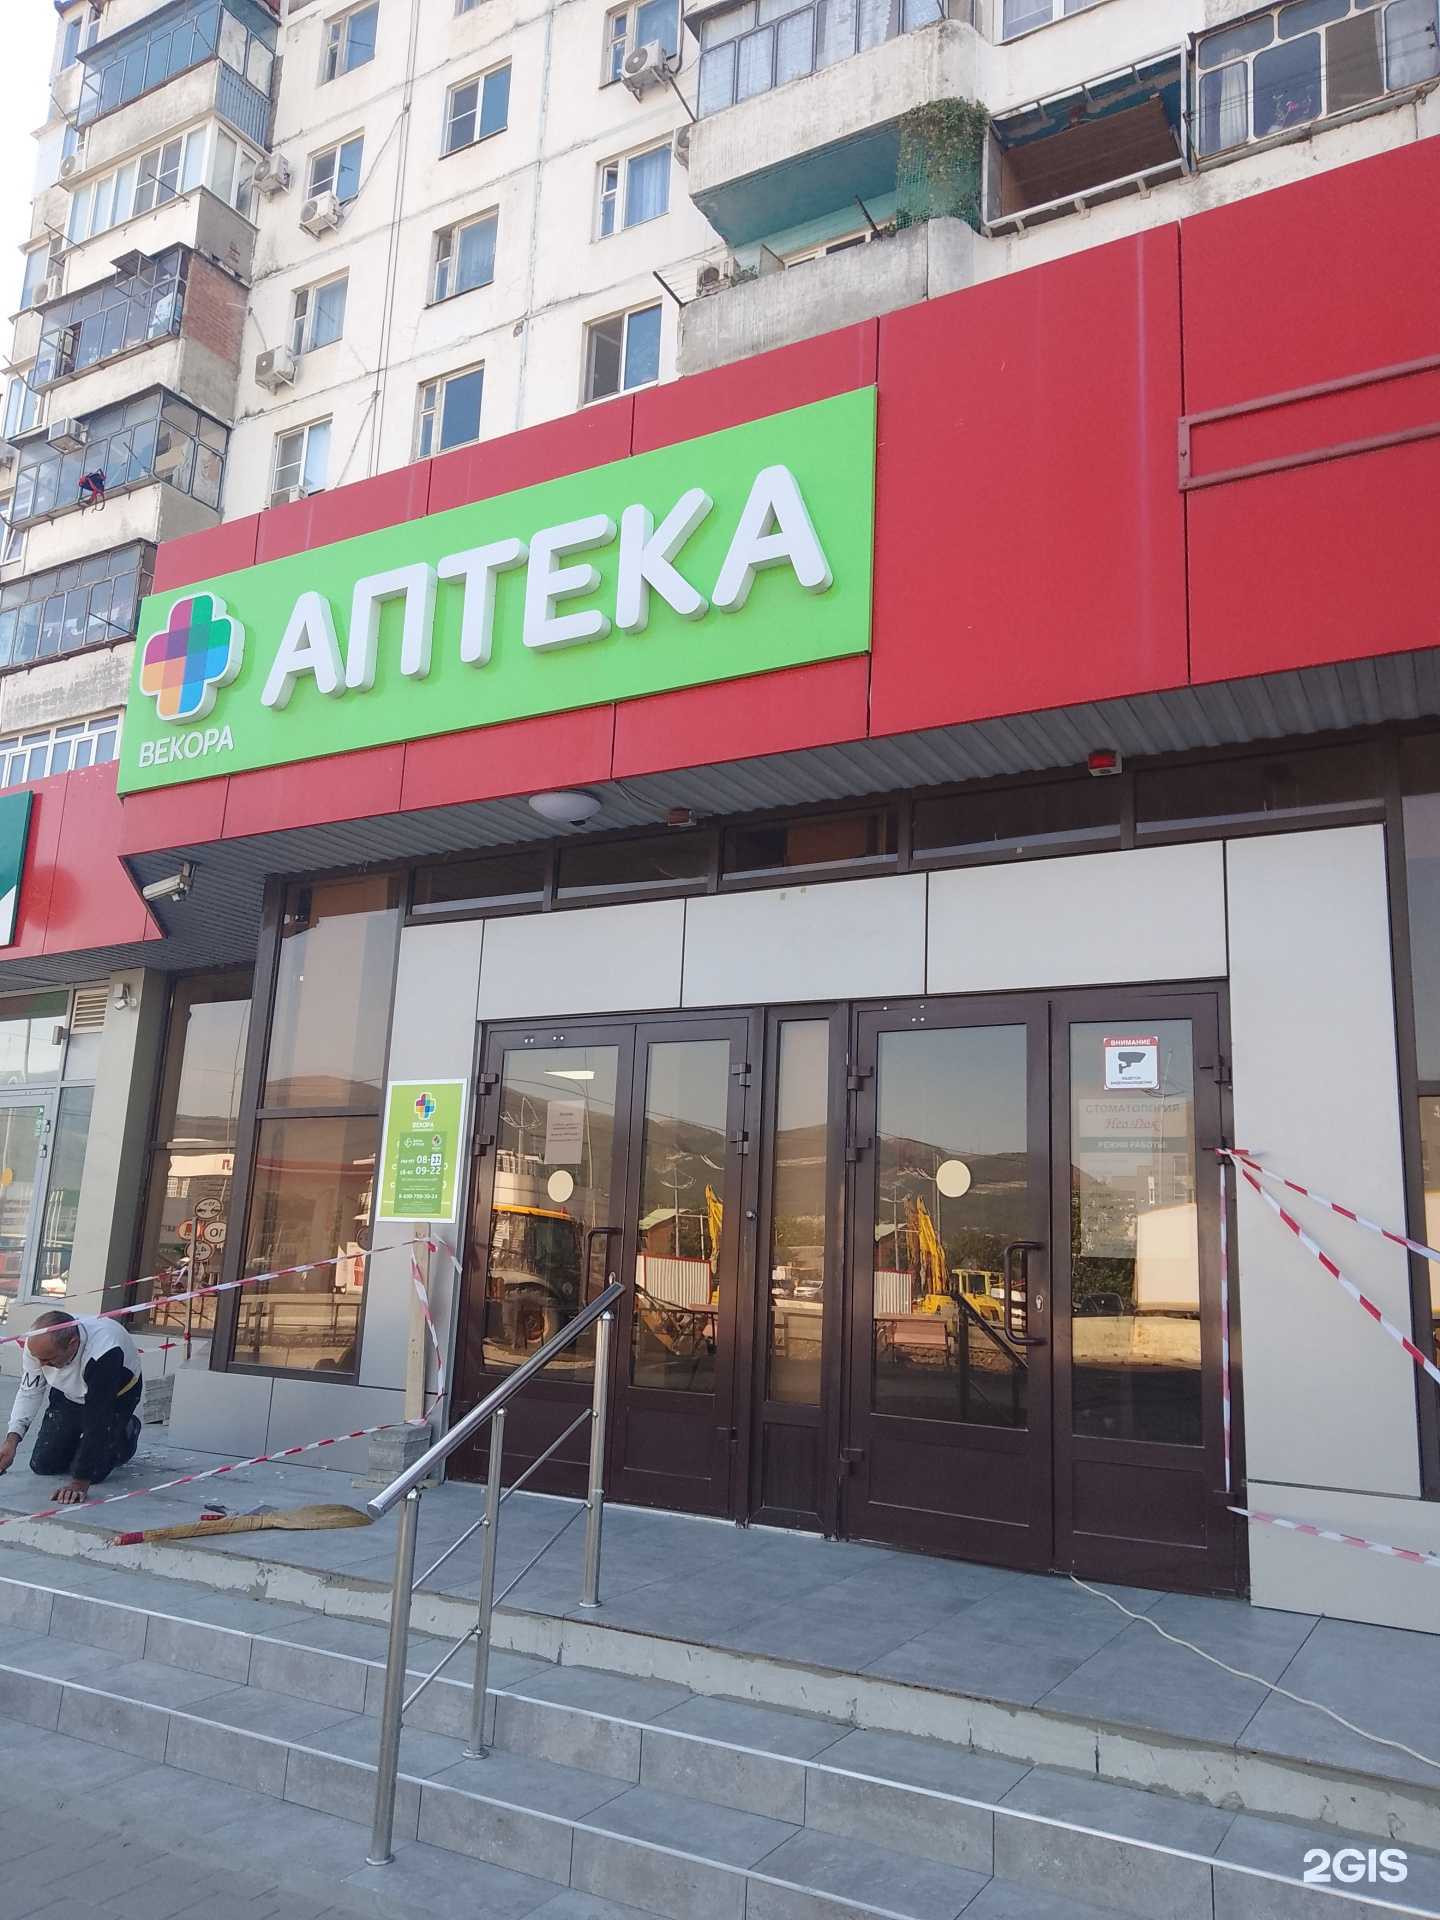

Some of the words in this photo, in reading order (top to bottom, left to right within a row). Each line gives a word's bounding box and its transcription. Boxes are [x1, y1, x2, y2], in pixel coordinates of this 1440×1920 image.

[260, 463, 834, 712] АПТЕКА
[138, 725, 234, 768] ВЕКОРА
[1110, 1038, 1152, 1046] ВНИМАНИЕ
